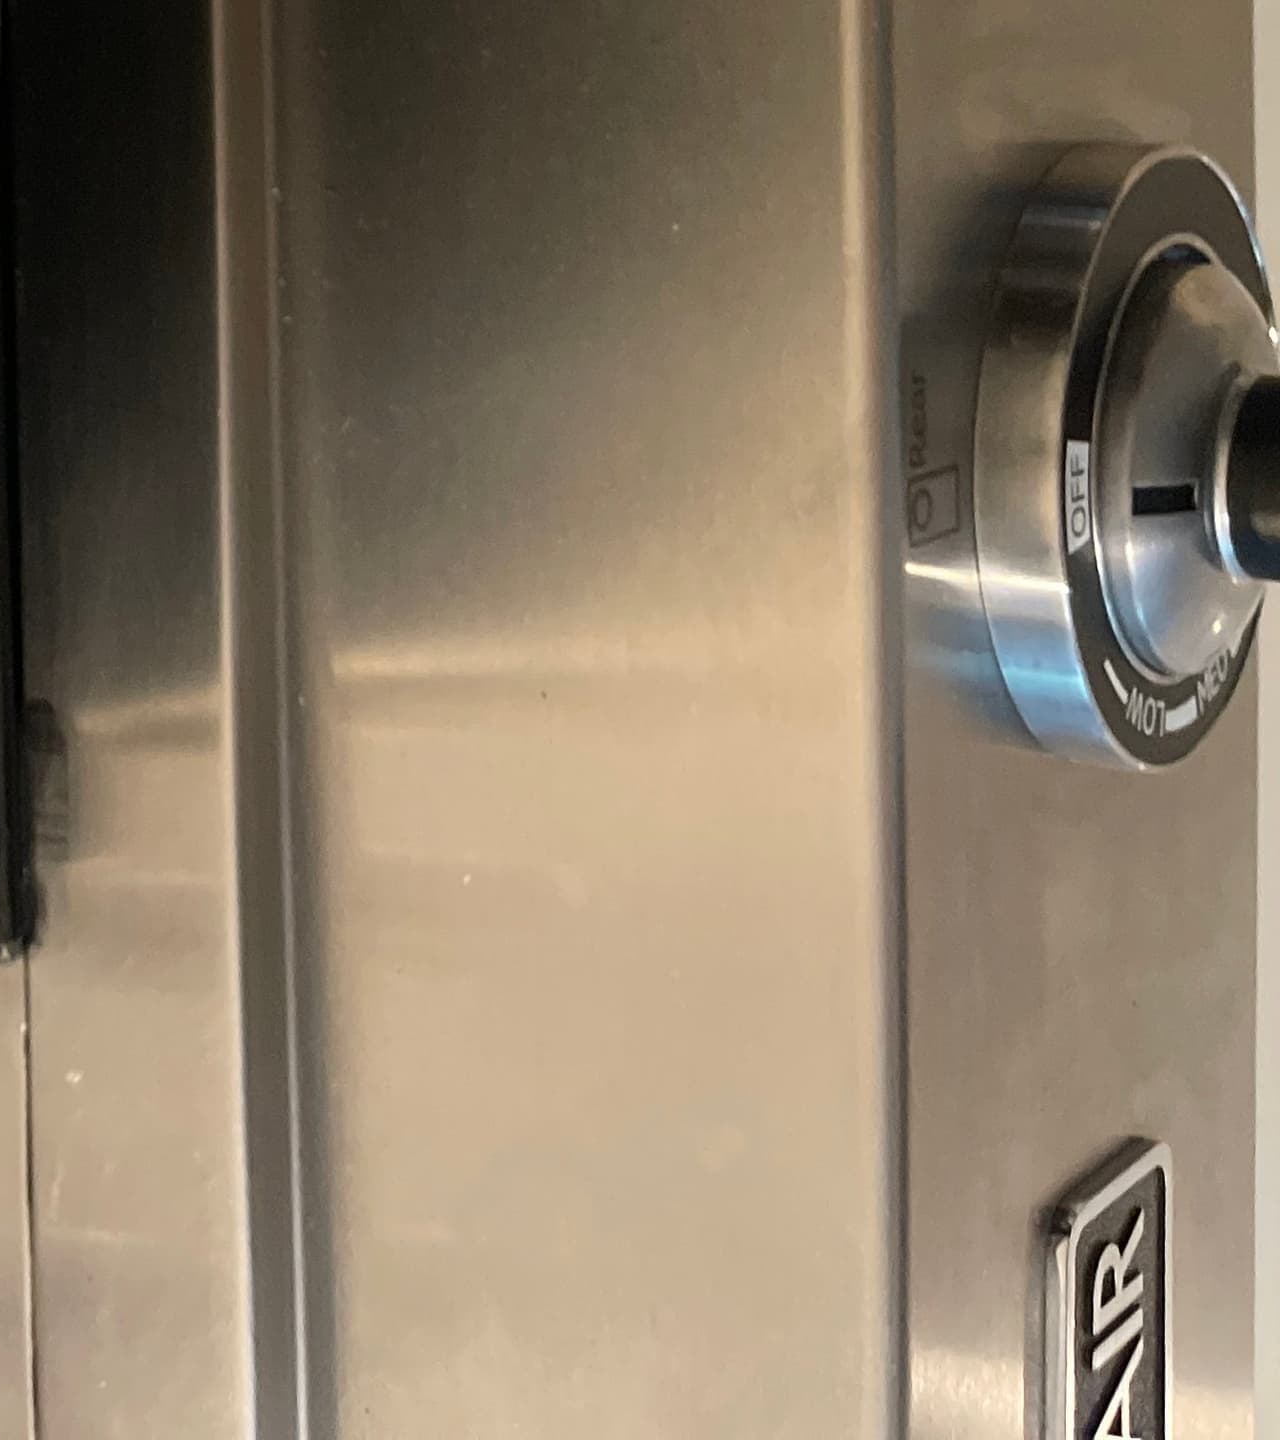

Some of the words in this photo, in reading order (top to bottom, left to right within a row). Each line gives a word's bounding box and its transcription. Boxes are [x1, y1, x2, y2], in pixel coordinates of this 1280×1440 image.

[909, 368, 928, 468] Rear
[1071, 454, 1086, 537] OFF
[1126, 687, 1165, 736] LOW
[1197, 653, 1228, 715] MED
